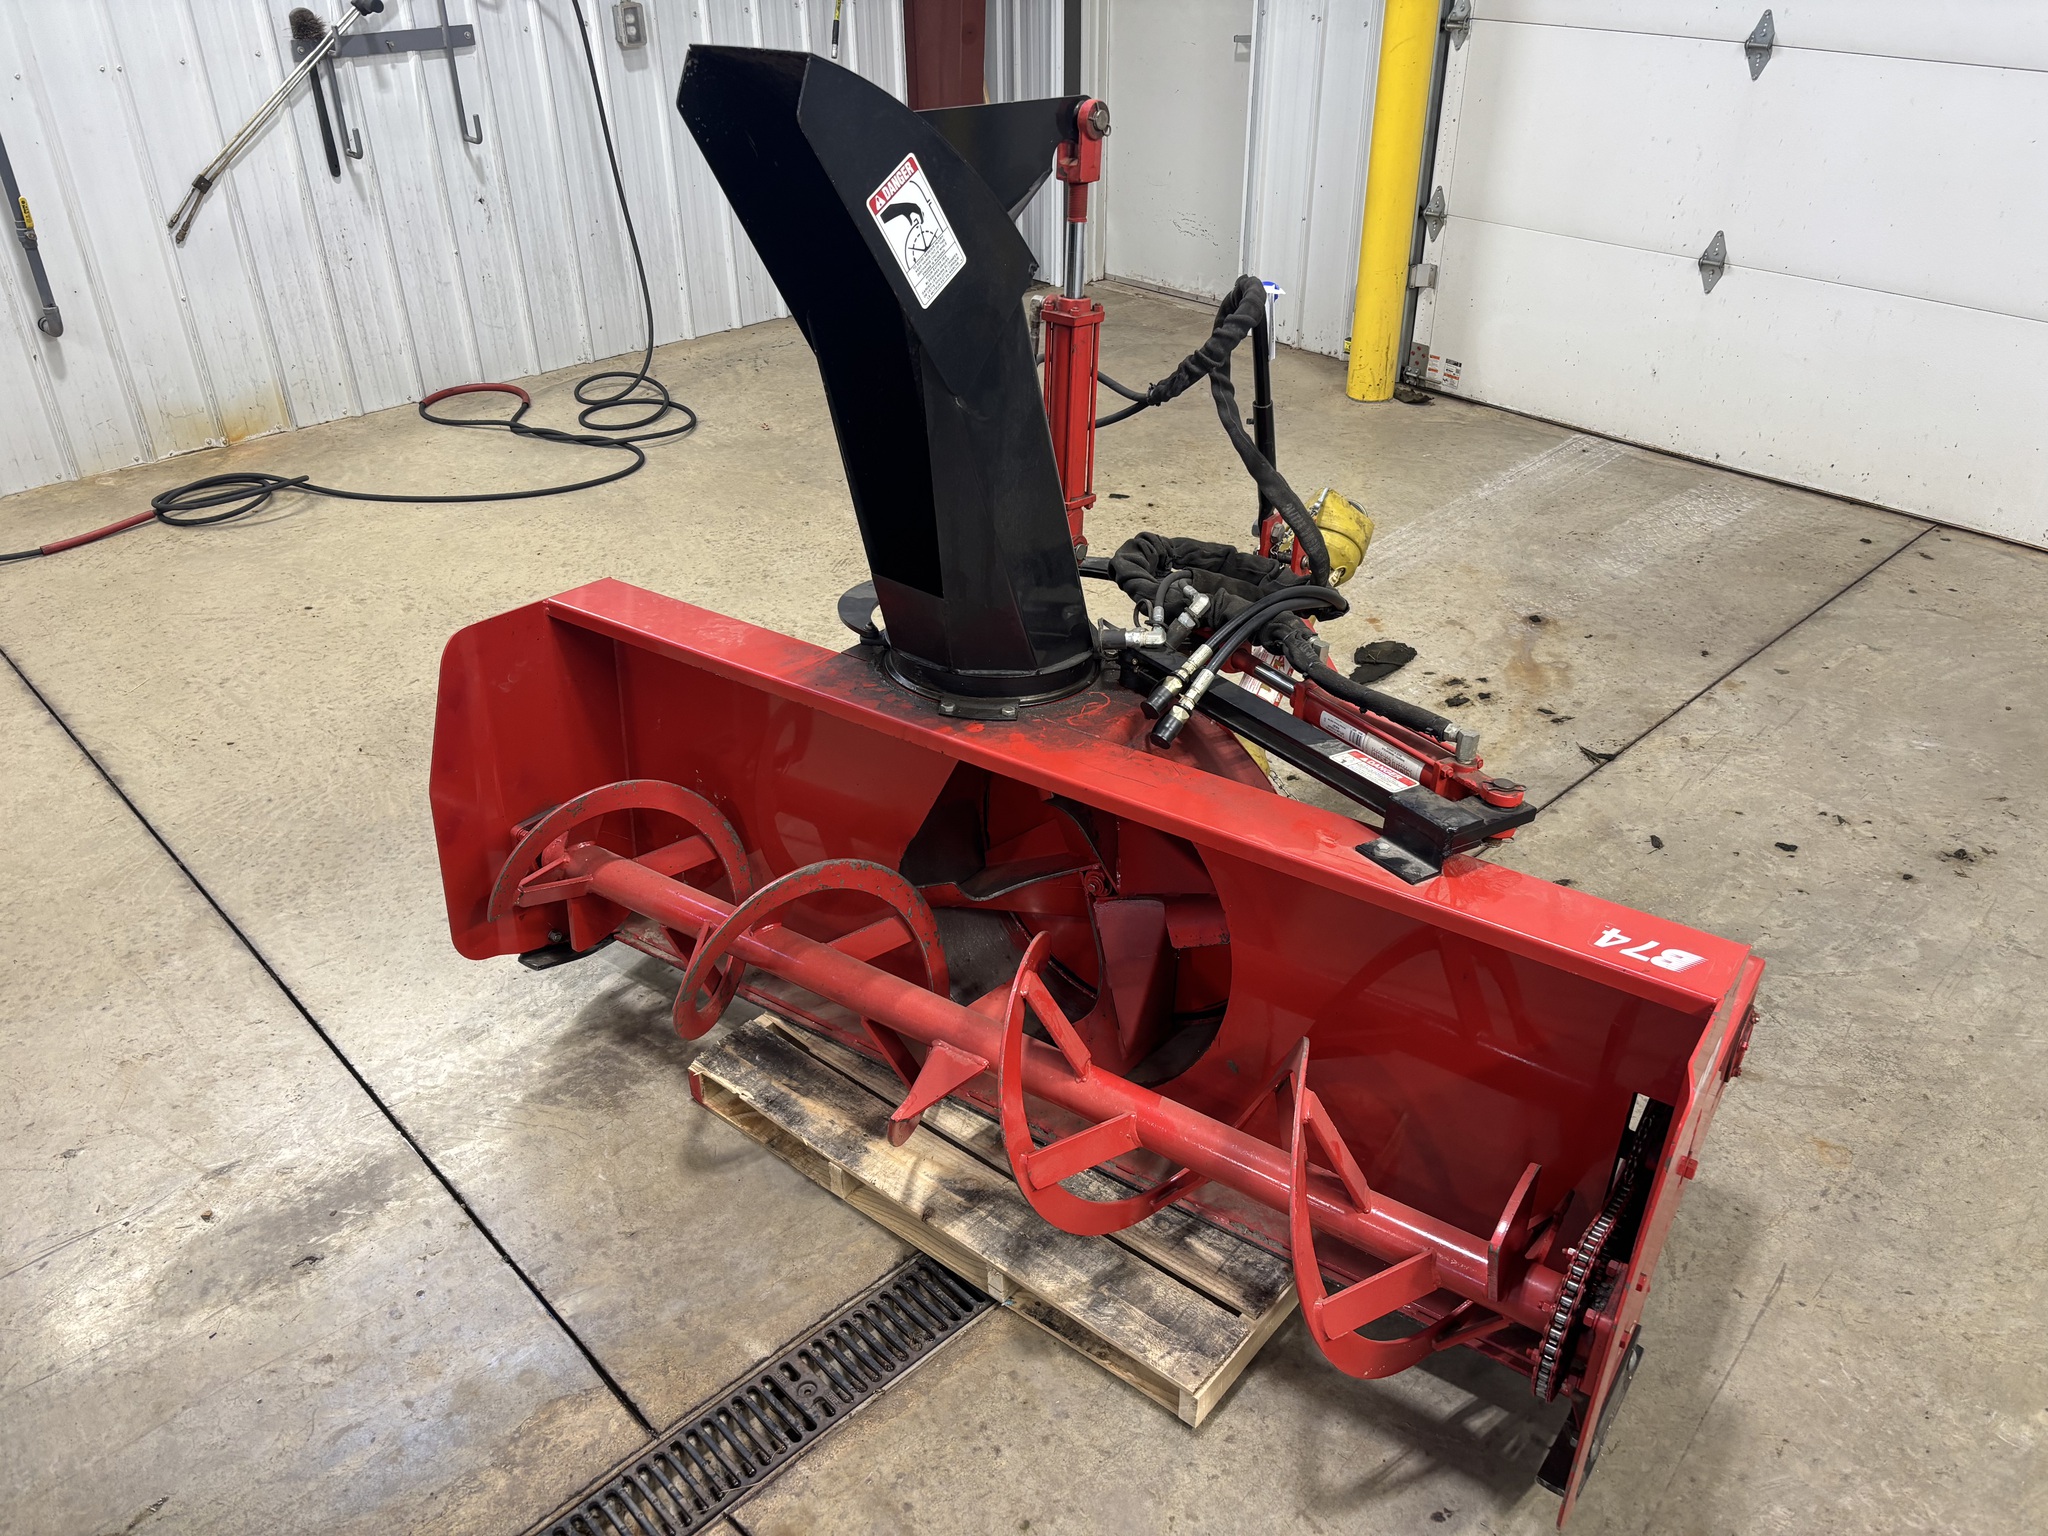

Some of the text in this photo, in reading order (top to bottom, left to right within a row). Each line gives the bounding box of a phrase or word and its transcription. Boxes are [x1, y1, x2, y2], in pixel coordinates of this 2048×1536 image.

[882, 161, 914, 200] DANGER
[1365, 760, 1403, 779] DANGER
[1594, 927, 1708, 973] B74
